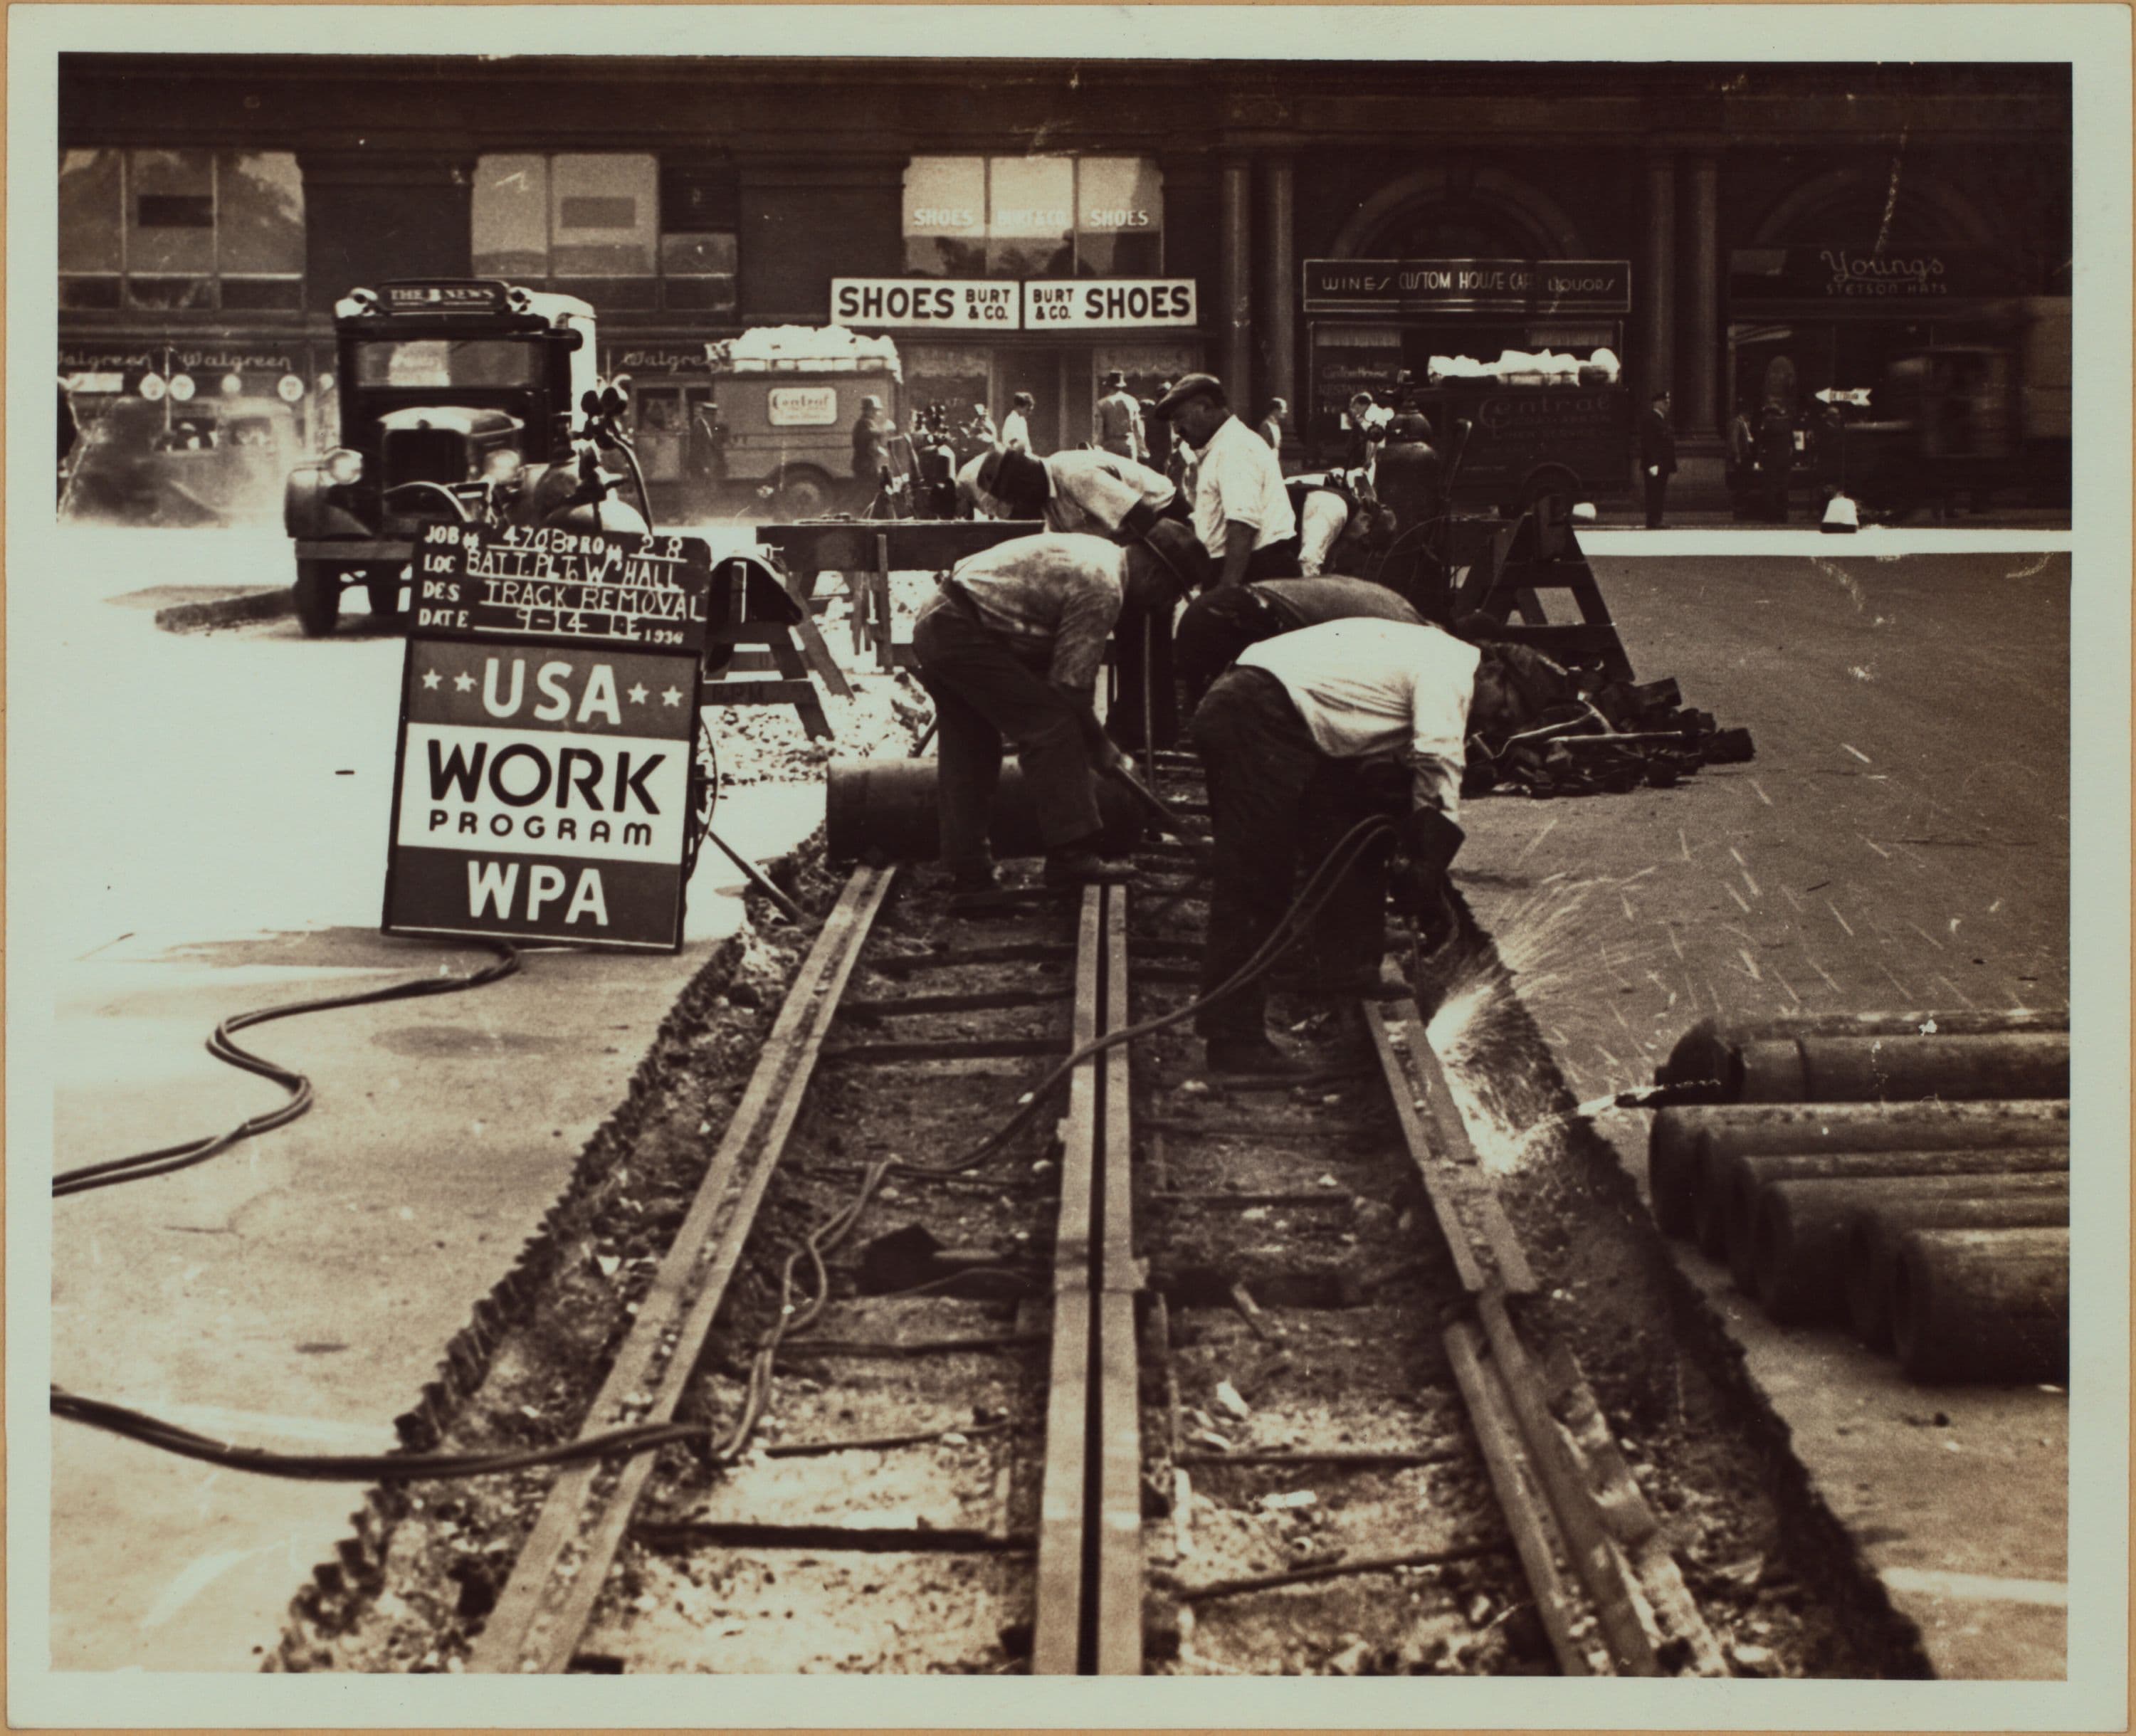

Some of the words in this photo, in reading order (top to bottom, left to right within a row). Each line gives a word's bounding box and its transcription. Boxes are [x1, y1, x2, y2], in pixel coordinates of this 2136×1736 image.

[914, 209, 974, 226] SHOES
[1090, 209, 1149, 227] SHOES
[1322, 276, 1391, 290] WINES
[1399, 271, 1451, 290] CUSTOM
[1459, 271, 1504, 290] HOUSE
[1547, 278, 1615, 291] LIQUORS
[1908, 283, 1947, 295] HATS
[444, 288, 495, 300] NEWS
[838, 287, 955, 320] SHOES
[966, 288, 1011, 304] BURT
[1033, 288, 1074, 303] BURT
[1085, 286, 1191, 320] SHOES
[967, 306, 979, 320] &
[984, 306, 1009, 320] CO.
[1035, 306, 1046, 320] &
[1049, 306, 1072, 320] CO.
[177, 352, 293, 374] Walgreen
[1478, 393, 1612, 428] Central
[424, 525, 460, 545] JOB
[566, 535, 605, 555] PRO
[423, 554, 456, 574] LOC
[422, 580, 461, 603] DES
[484, 580, 567, 609] TRACK
[581, 586, 707, 622] REMOVAL
[419, 609, 468, 628] DATE
[483, 658, 621, 725] USA
[427, 739, 667, 816] WORK
[428, 809, 653, 846] PROGRAM
[467, 860, 609, 926] WPA
